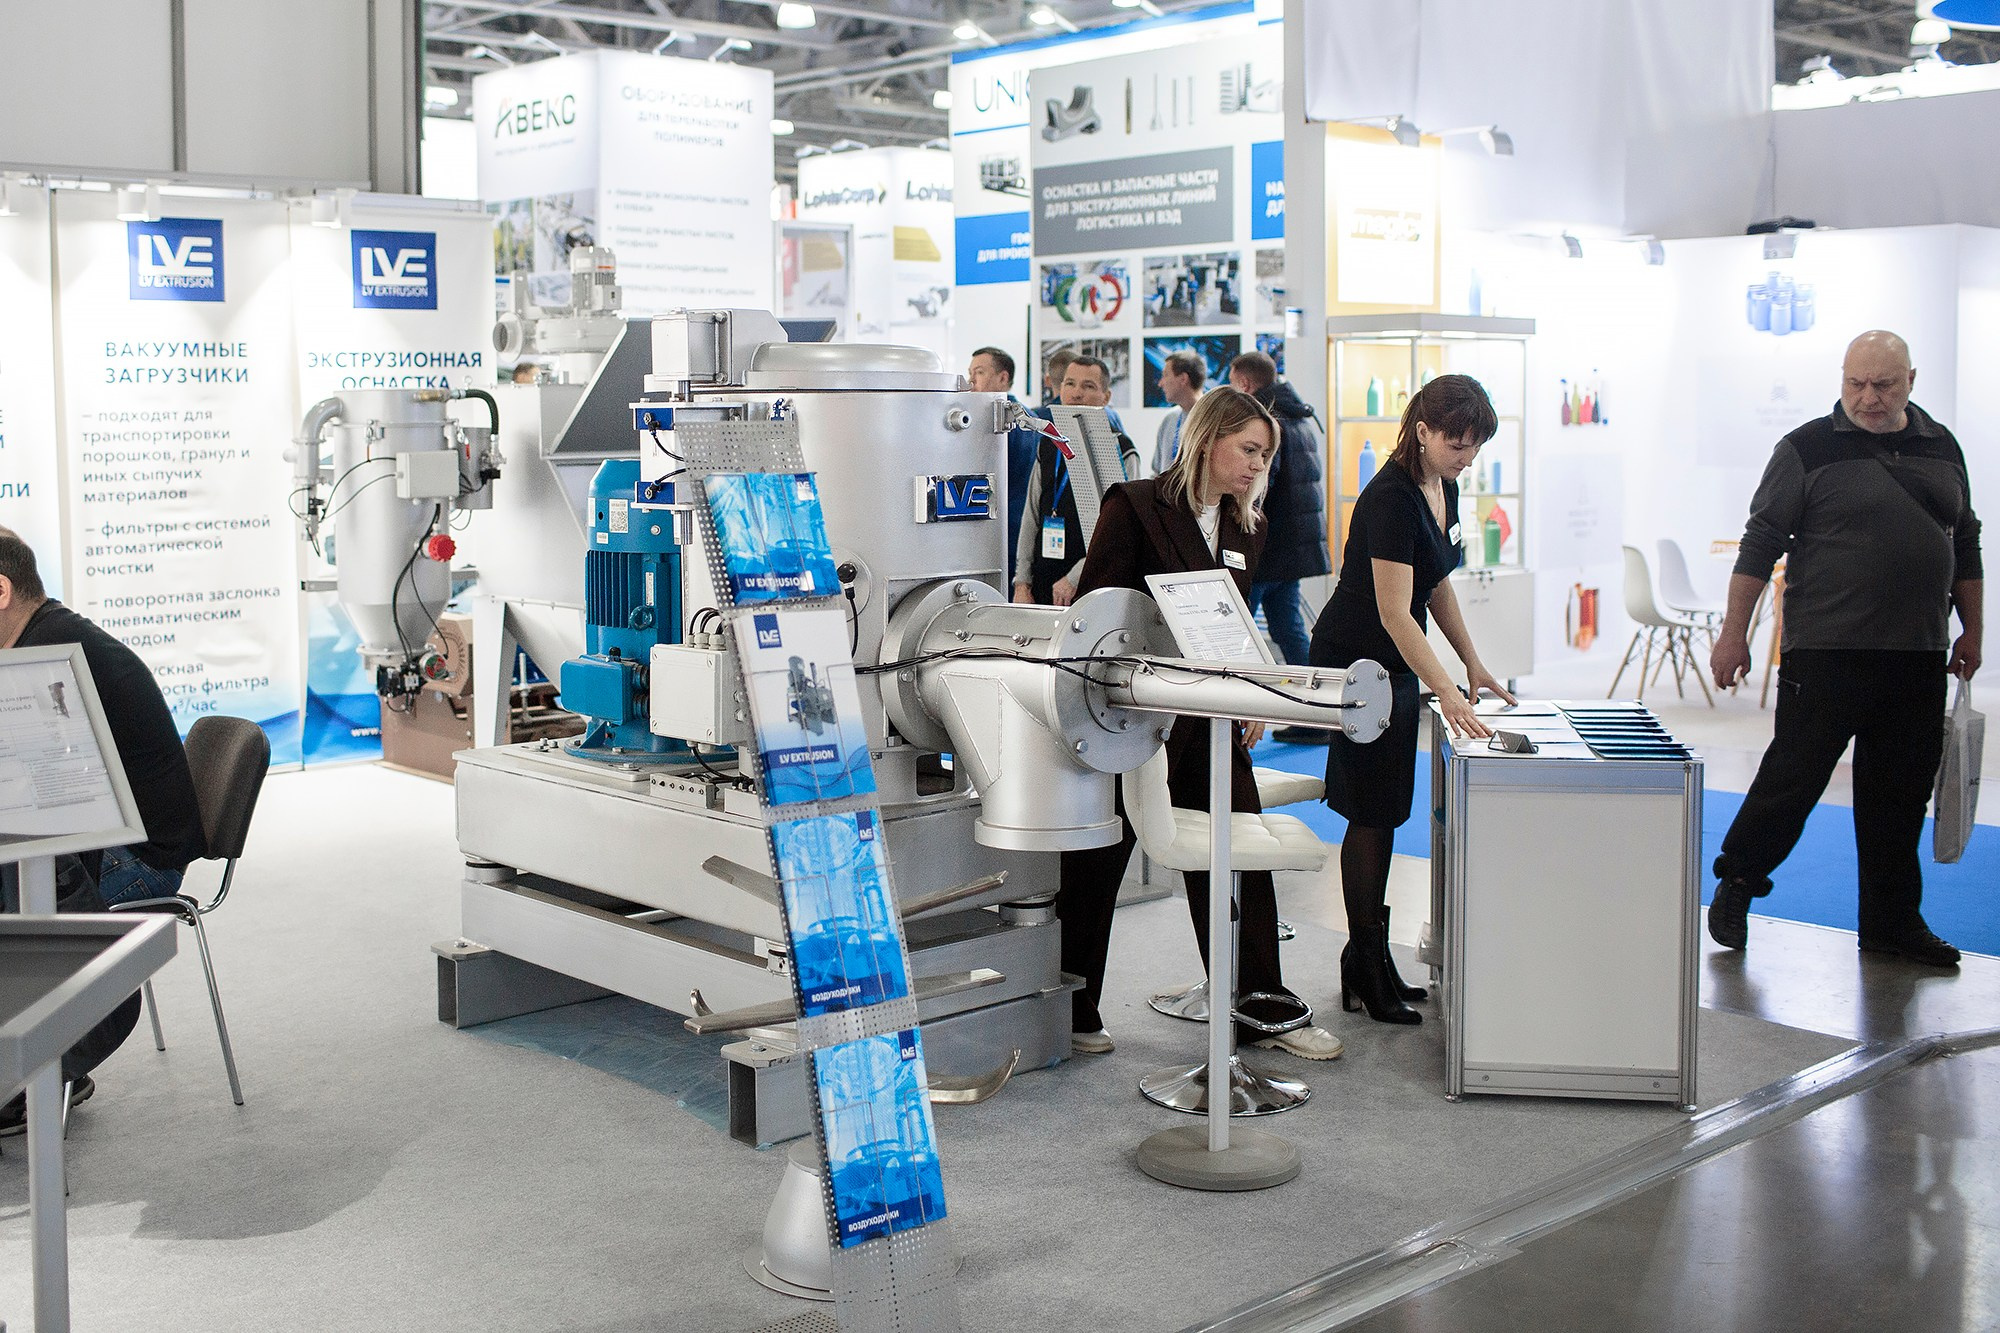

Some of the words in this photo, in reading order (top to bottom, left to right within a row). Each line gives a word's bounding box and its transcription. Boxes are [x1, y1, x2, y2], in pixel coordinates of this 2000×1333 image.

[1042, 181, 1100, 199] ОСНАСТКА
[1102, 181, 1112, 194] И
[1113, 173, 1177, 192] ЗАПАСНЫЕ
[1179, 169, 1219, 185] ЧАСТИ
[1044, 201, 1070, 219] ДЛЯ
[1071, 191, 1170, 214] ЭКСТРУЗИОННЫХ
[1172, 184, 1217, 205] ЛИНИЙ
[1075, 211, 1144, 231] ЛОГИСТИКА
[1145, 210, 1154, 224] И
[1156, 208, 1182, 225] ВЭД
[138, 234, 214, 277] LVE
[360, 247, 428, 286] LVE
[156, 274, 214, 288] EXTRUSION
[375, 285, 428, 297] EXTRUSION
[105, 341, 248, 358] ВАКУУМНЫЕ
[308, 351, 482, 368] ЭКСТРУЗИОННАЯ
[105, 367, 249, 383] ЗАГРУЗЧИКИ
[342, 376, 450, 389] ОСНАСТКА
[98, 411, 179, 423] подходят
[183, 410, 213, 423] для
[83, 429, 231, 444] транспортировки
[83, 449, 176, 467] порошков,
[181, 447, 236, 465] гранул
[241, 448, 251, 458] и
[83, 470, 127, 483] иных
[132, 468, 203, 485] сыпучих
[84, 488, 188, 505] материалов
[937, 480, 989, 515] LVE
[101, 520, 178, 539] фильтры
[183, 521, 191, 531] с
[195, 513, 271, 530] системой
[85, 535, 224, 557] автоматической
[86, 562, 154, 577] очистки
[745, 578, 755, 588] LV
[103, 591, 204, 609] поворотная
[208, 585, 281, 603] заслонка
[101, 607, 242, 629] пневматическим
[759, 629, 780, 644] LVE
[201, 674, 269, 695] фильтра
[779, 753, 790, 765] LV
[901, 1046, 916, 1059] LVE
